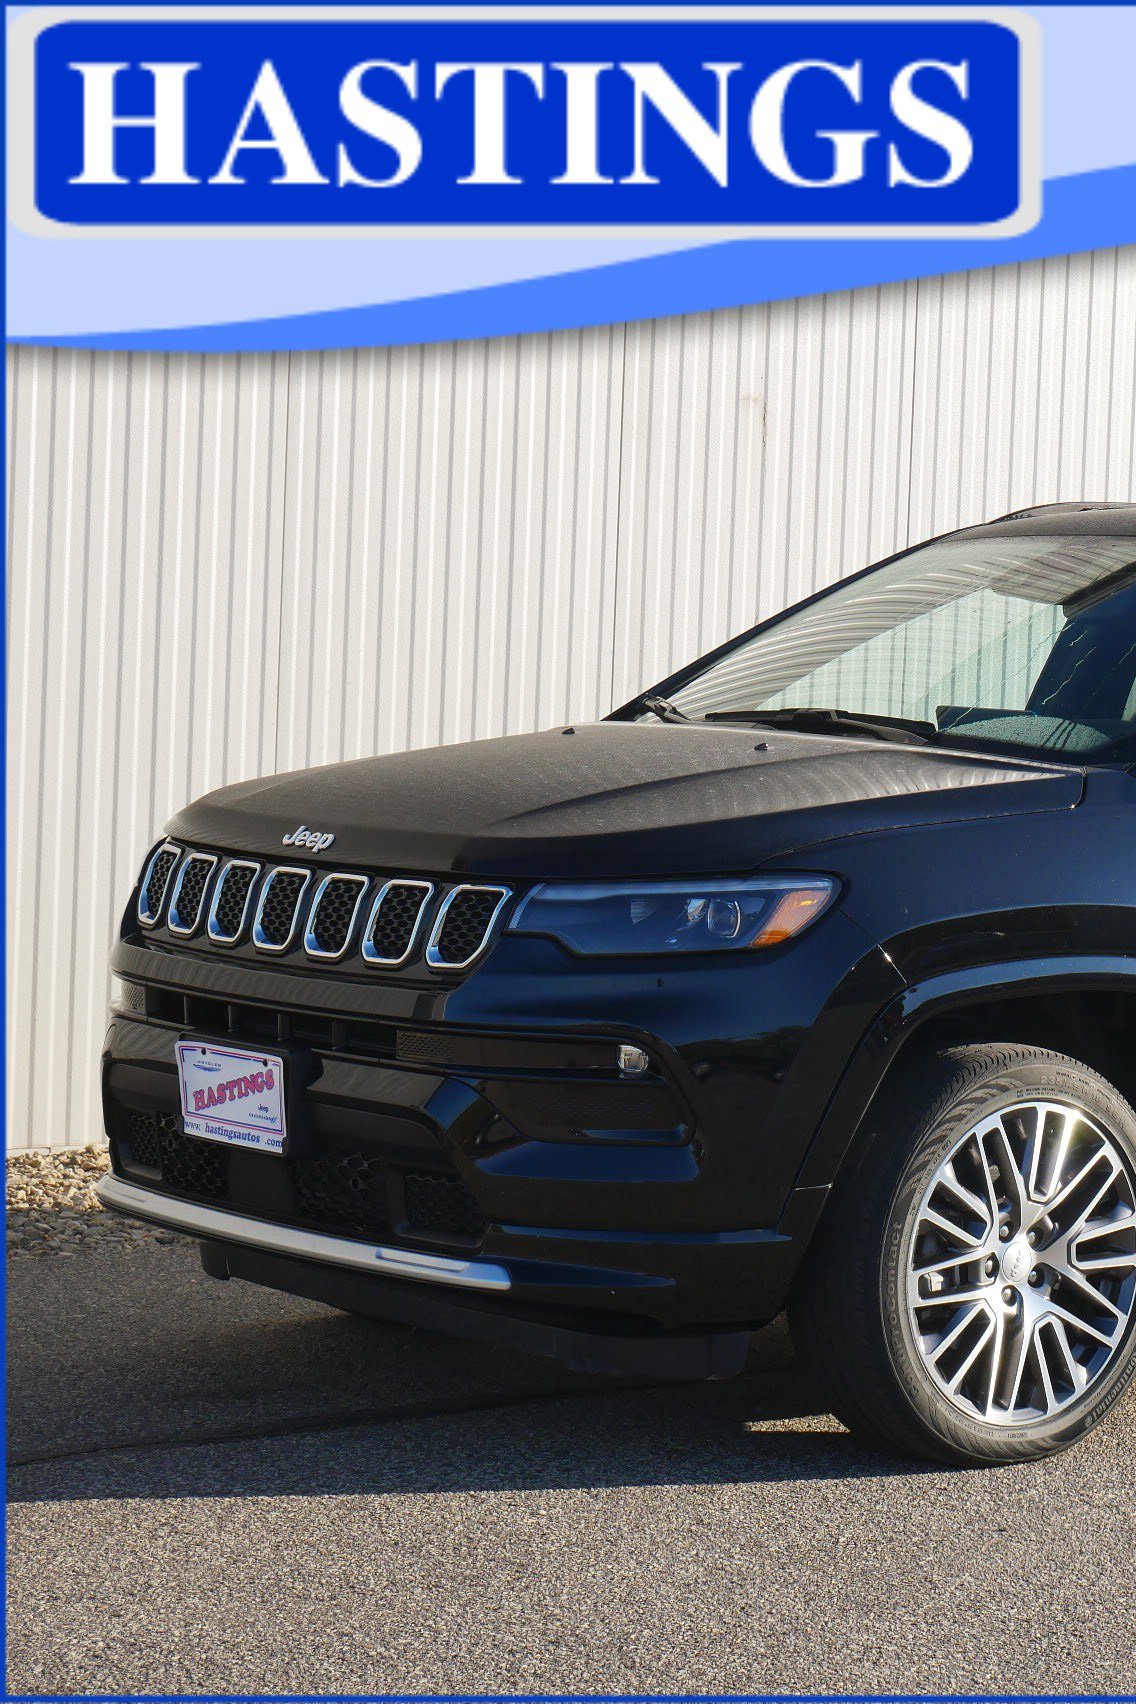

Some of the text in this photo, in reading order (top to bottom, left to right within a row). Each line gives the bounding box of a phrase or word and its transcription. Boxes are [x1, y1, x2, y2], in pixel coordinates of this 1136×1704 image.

[282, 825, 335, 854] Jeep
[193, 1069, 274, 1111] HASTINGS
[258, 1103, 269, 1113] Jeep
[205, 1122, 261, 1142] hastingsautos
